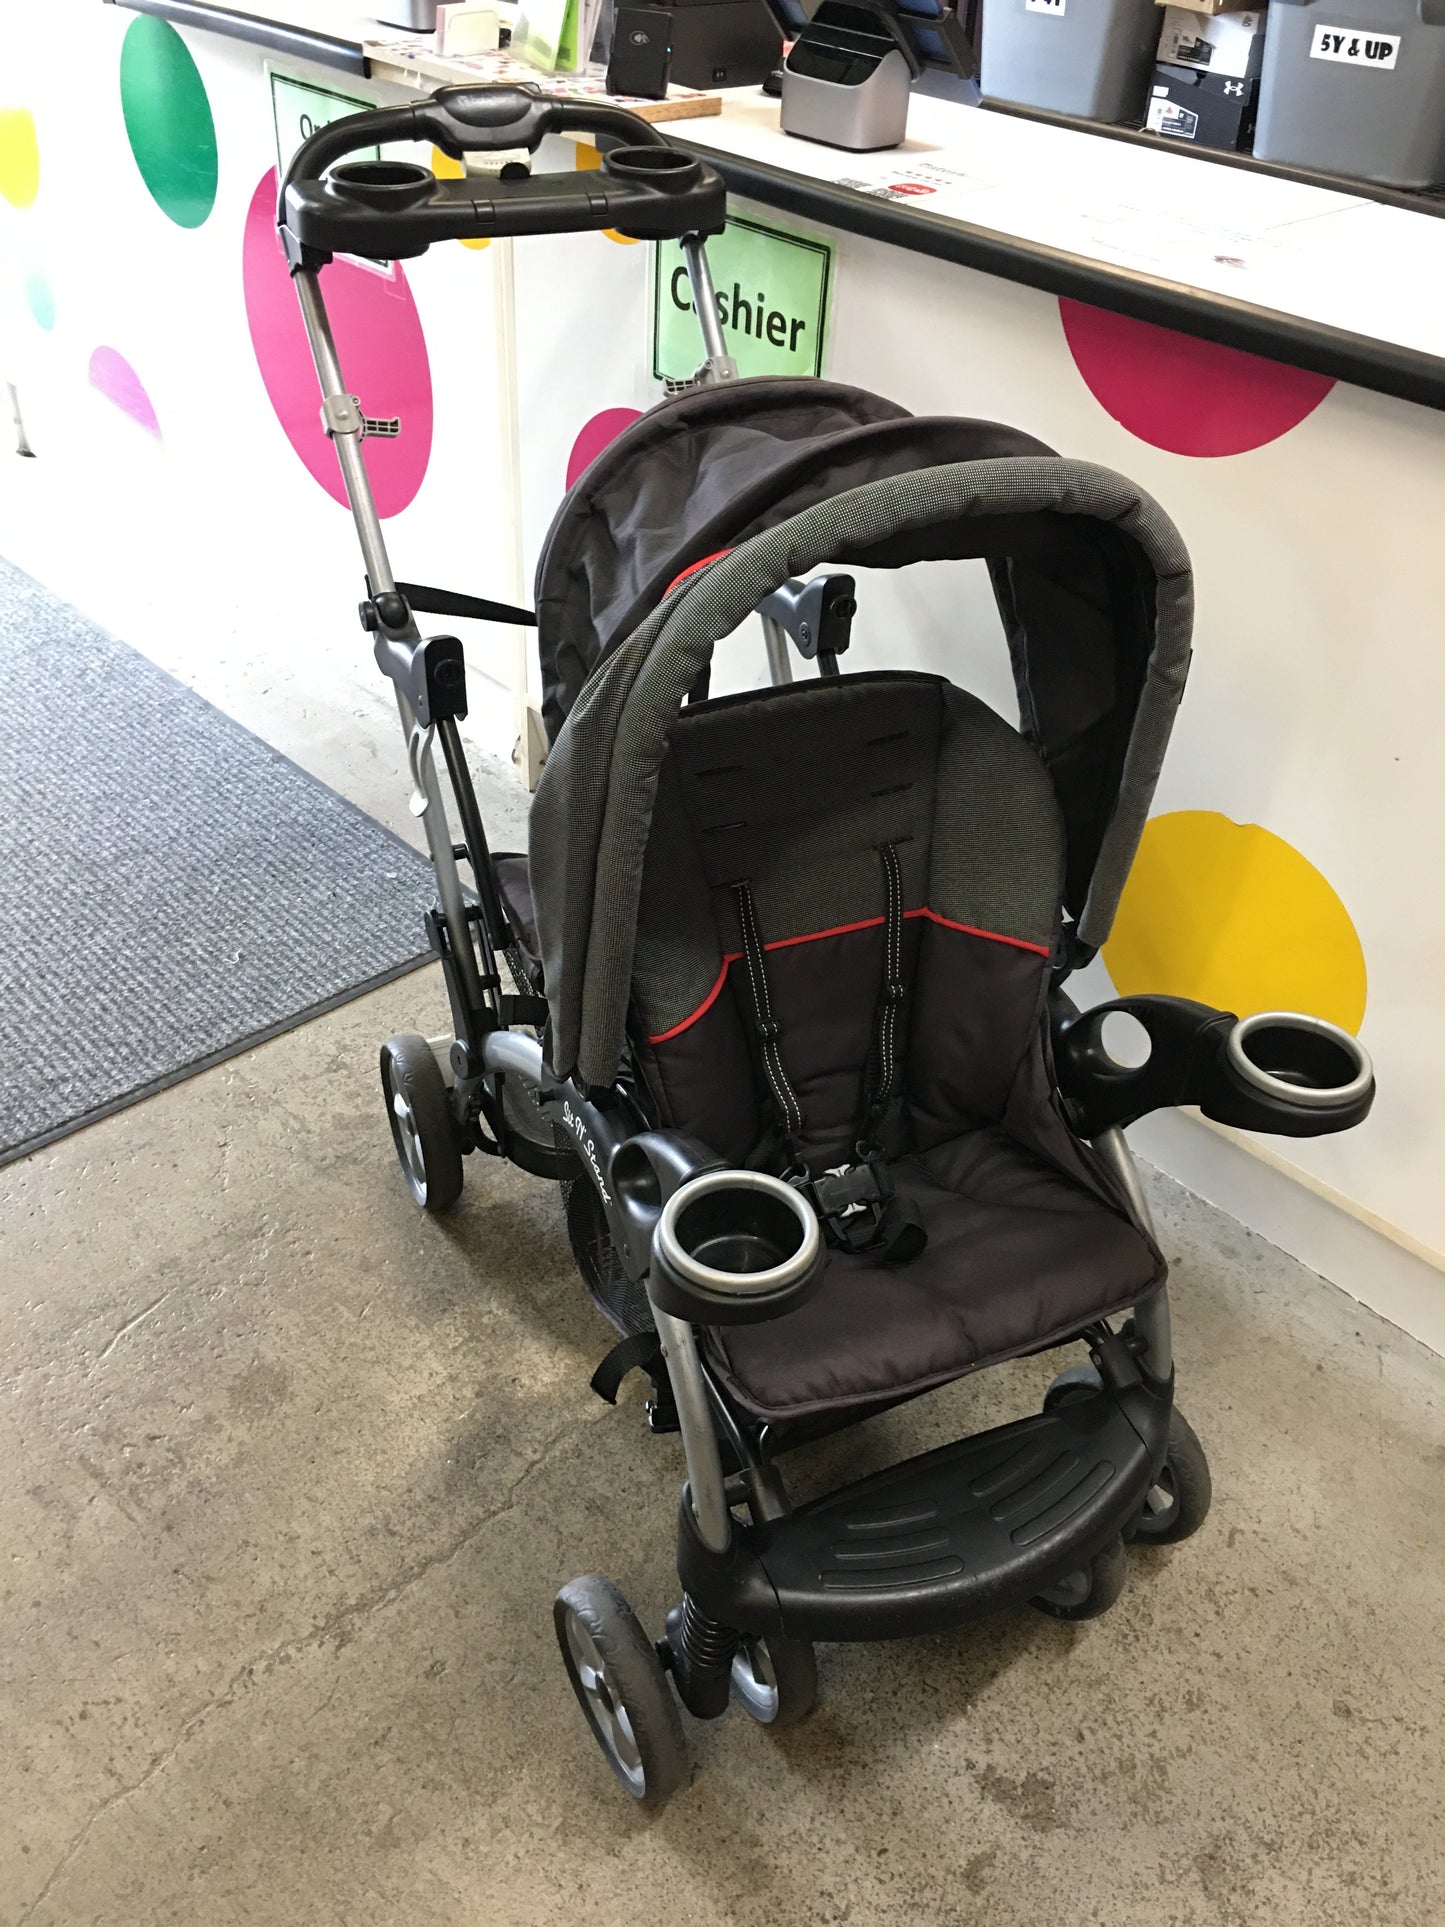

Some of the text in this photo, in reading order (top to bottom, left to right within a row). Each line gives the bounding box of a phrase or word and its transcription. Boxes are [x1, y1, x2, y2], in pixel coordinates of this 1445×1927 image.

[1320, 33, 1393, 60] 5Y & UP
[671, 266, 805, 352] Cshier
[562, 1100, 574, 1128] Sit
[583, 1139, 612, 1204] Stand
